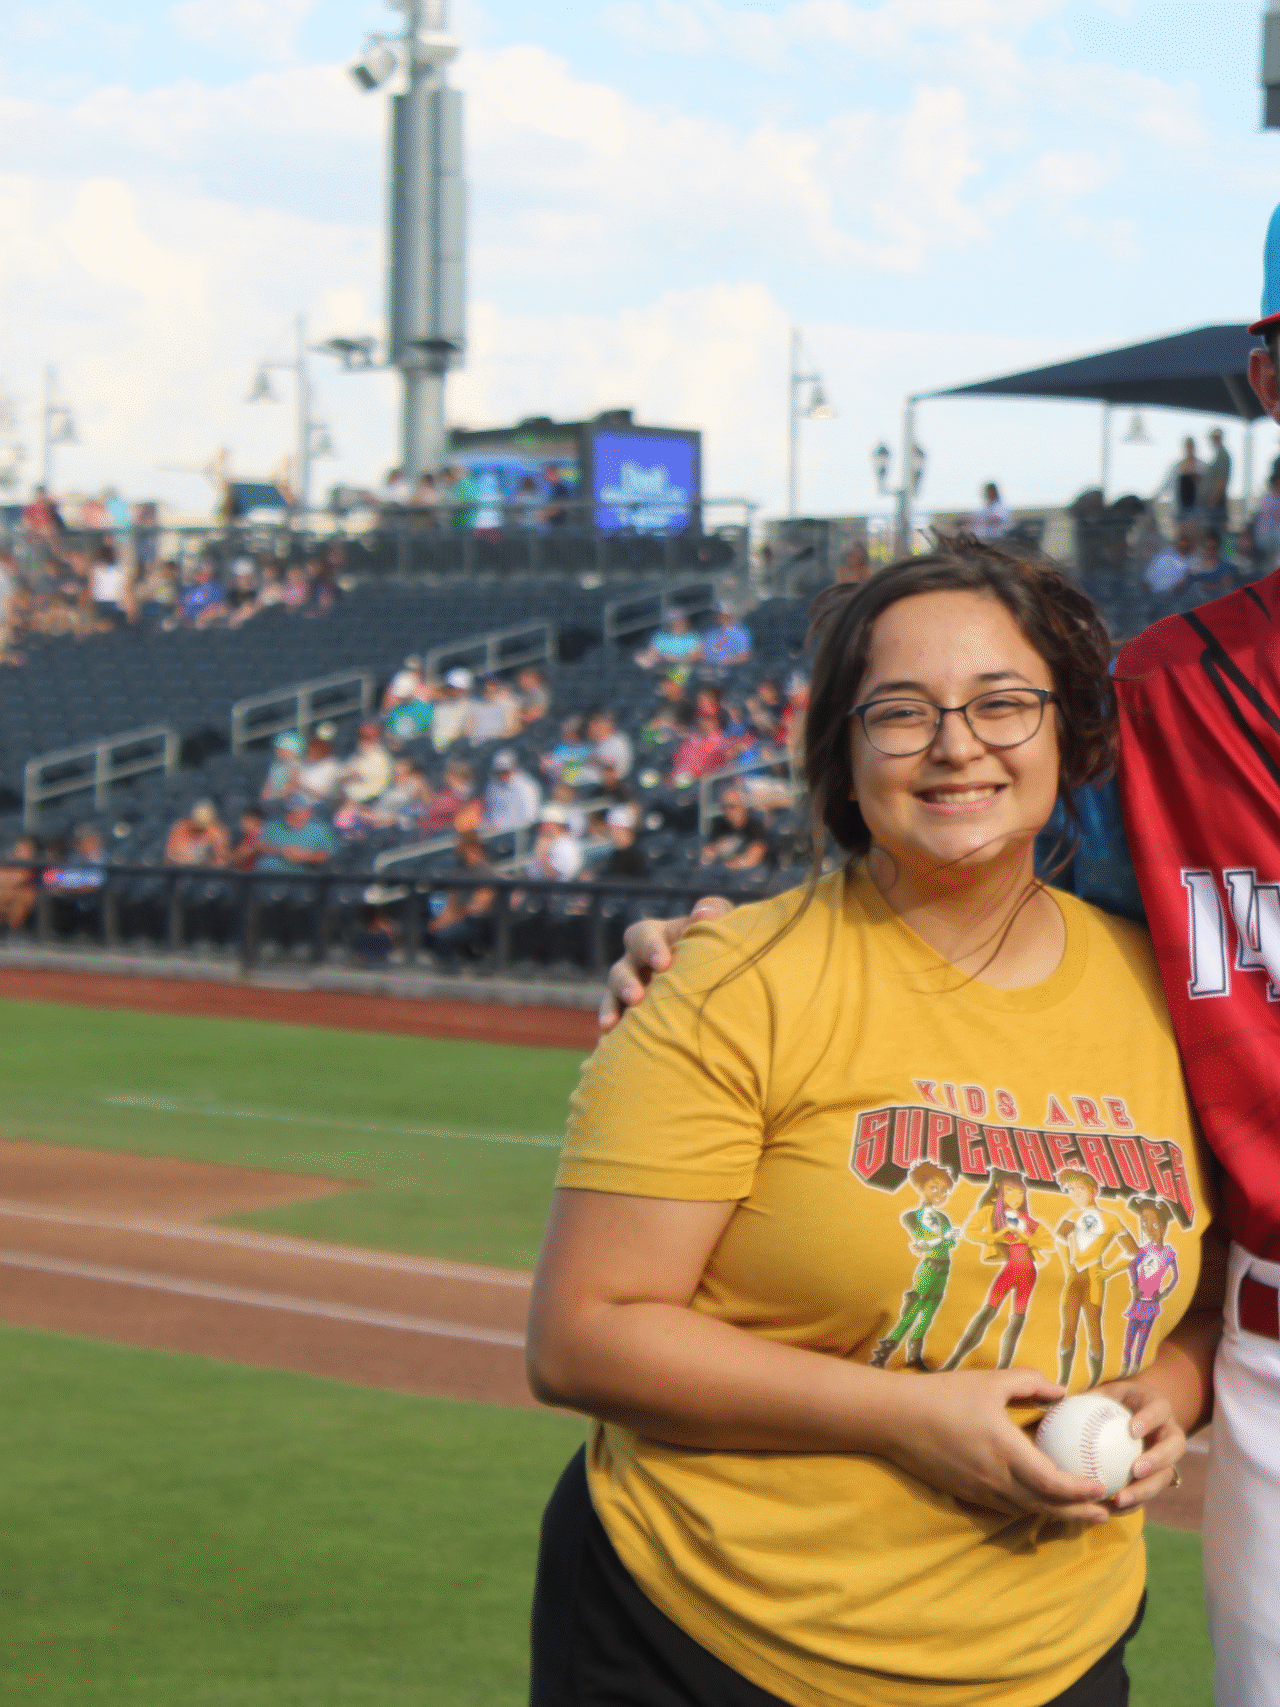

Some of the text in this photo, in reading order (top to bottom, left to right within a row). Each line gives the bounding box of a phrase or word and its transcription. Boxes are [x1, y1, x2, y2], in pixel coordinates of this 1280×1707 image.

[912, 1078, 1135, 1131] KIDS ARE
[850, 1106, 1197, 1233] SUPERHEROES
